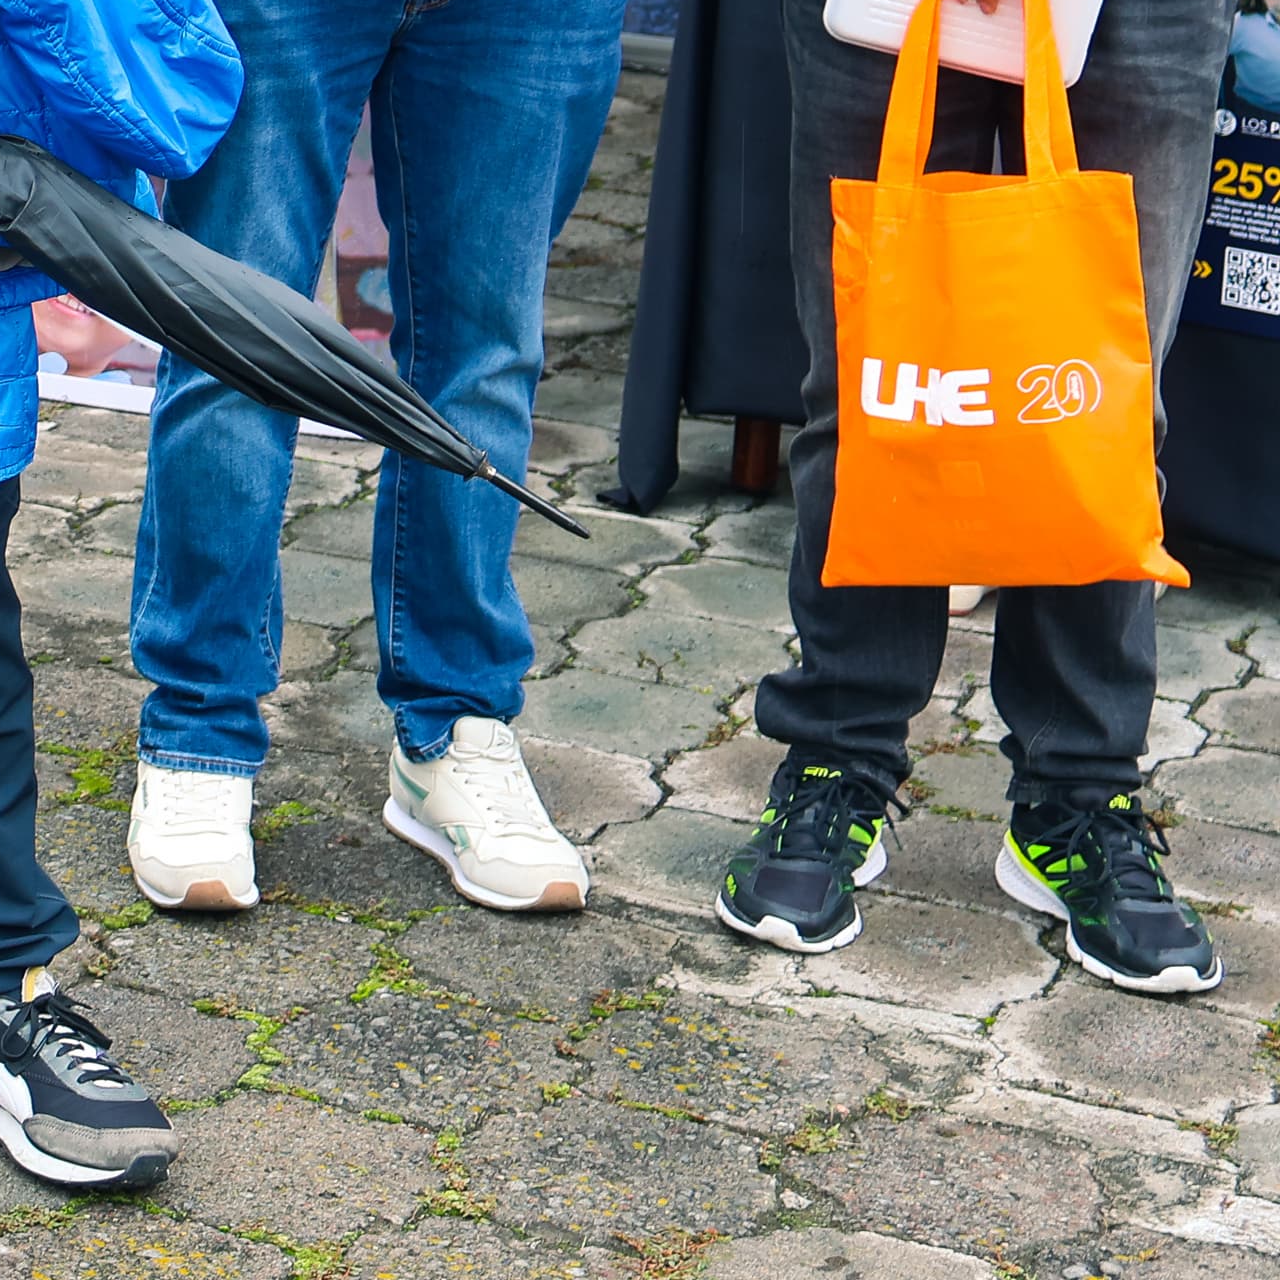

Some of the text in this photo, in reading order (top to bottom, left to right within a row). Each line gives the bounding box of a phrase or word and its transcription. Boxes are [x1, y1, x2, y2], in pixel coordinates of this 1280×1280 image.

[1241, 116, 1268, 133] LOS
[860, 356, 1102, 427] UHE 20
